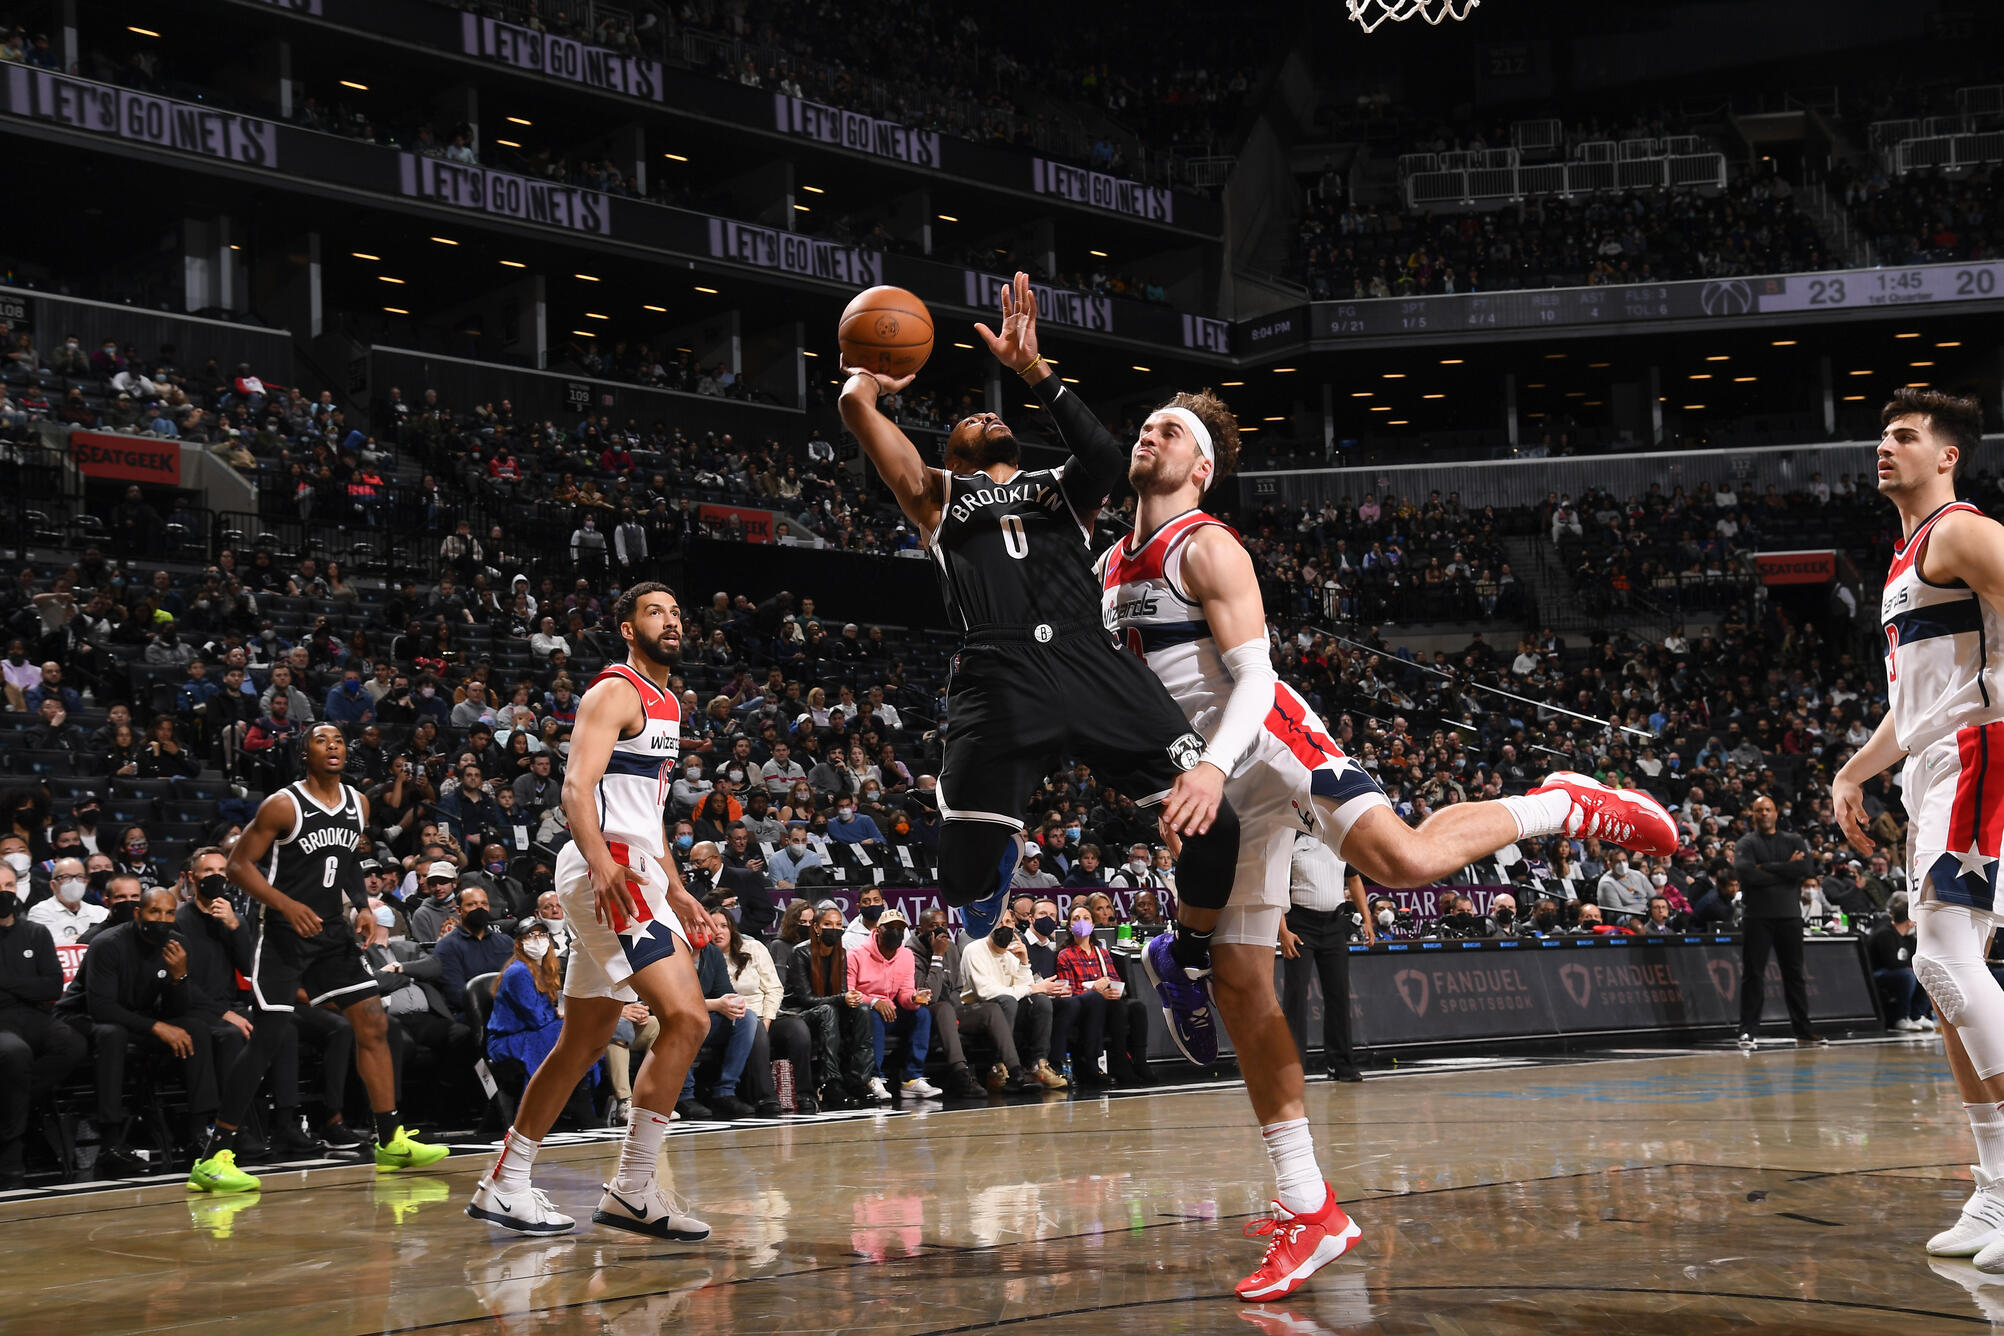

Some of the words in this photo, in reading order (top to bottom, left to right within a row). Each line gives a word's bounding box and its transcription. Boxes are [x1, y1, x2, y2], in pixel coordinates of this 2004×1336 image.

[477, 16, 541, 67] LET'S
[549, 40, 577, 77] GO
[586, 48, 654, 98] NETS
[29, 68, 115, 129] LET'S
[127, 97, 164, 140] GO
[176, 108, 266, 164] NETS
[788, 95, 840, 140] LET'S
[846, 115, 869, 148] GO
[876, 121, 933, 166] NETS
[416, 155, 480, 204] LET'S
[491, 175, 520, 213] GO
[528, 181, 600, 233] NETS
[1043, 159, 1088, 201] LET'S
[1093, 177, 1114, 209] GO
[1117, 183, 1167, 220] NETS
[722, 219, 776, 264] LET'S
[785, 236, 808, 271] GO
[814, 241, 876, 285] NETS
[1808, 279, 1846, 305] 23
[1877, 271, 1923, 291] 1:45
[1956, 269, 1995, 295] 20
[1055, 289, 1106, 329] NETS
[1338, 305, 1356, 317] FG
[1402, 302, 1426, 314] 3PT
[1541, 310, 1555, 321] 10
[1659, 303, 1668, 315] 6
[1191, 316, 1230, 354] LET'
[1251, 326, 1273, 341] 8:04
[1274, 321, 1291, 335] PM
[76, 443, 174, 473] SEATGEEK
[951, 484, 1063, 523] BROOKLYN
[1000, 515, 1029, 560] 0
[1759, 560, 1830, 575] SEATGEEK
[1040, 626, 1047, 641] B
[323, 856, 339, 888] 6
[1432, 969, 1528, 995] FANDUEL
[1593, 964, 1679, 988] FANDUEL
[1438, 995, 1533, 1014] SPORTSBOOK
[1600, 988, 1683, 1006] SPORTSBOOK
